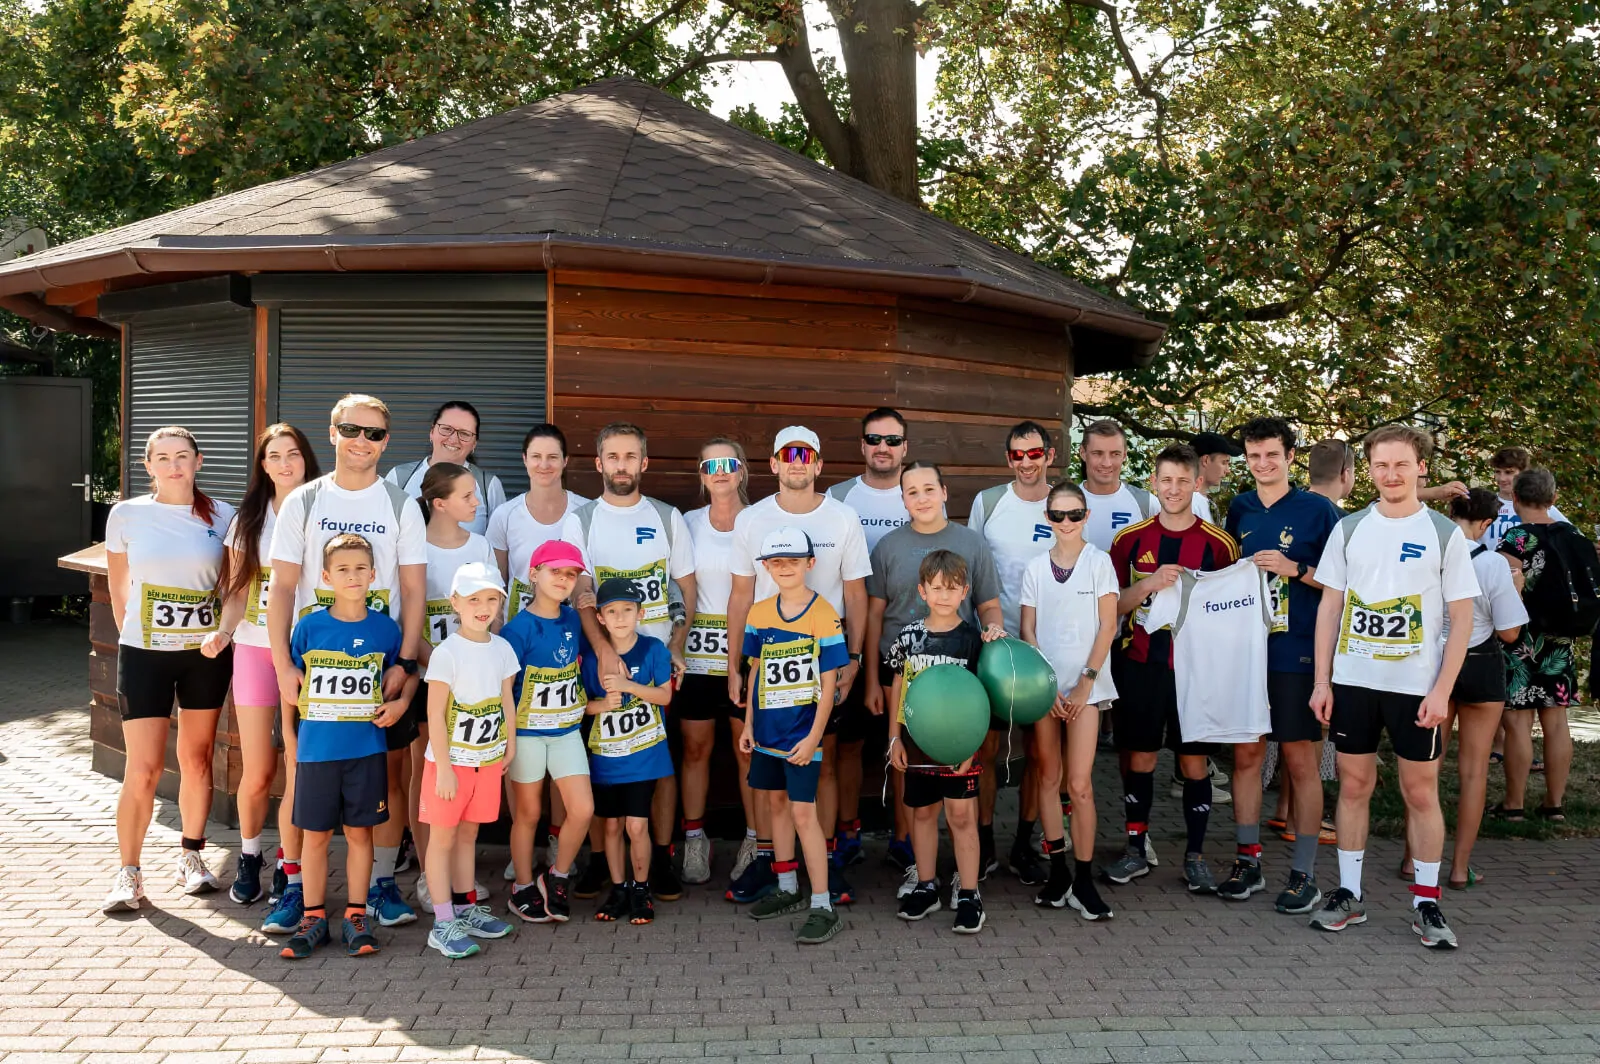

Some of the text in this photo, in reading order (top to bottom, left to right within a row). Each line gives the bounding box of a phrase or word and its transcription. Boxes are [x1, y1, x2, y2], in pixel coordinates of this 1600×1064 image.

[321, 517, 386, 534] faurecia
[860, 516, 909, 527] aureci
[162, 592, 178, 600] MEZI
[634, 580, 660, 601] 68
[156, 604, 212, 627] 376
[1353, 611, 1406, 637] 382
[336, 659, 362, 667] MOSTY
[767, 658, 814, 685] 367
[312, 675, 372, 695] 1196
[537, 681, 577, 707] 110
[603, 703, 650, 736] 108
